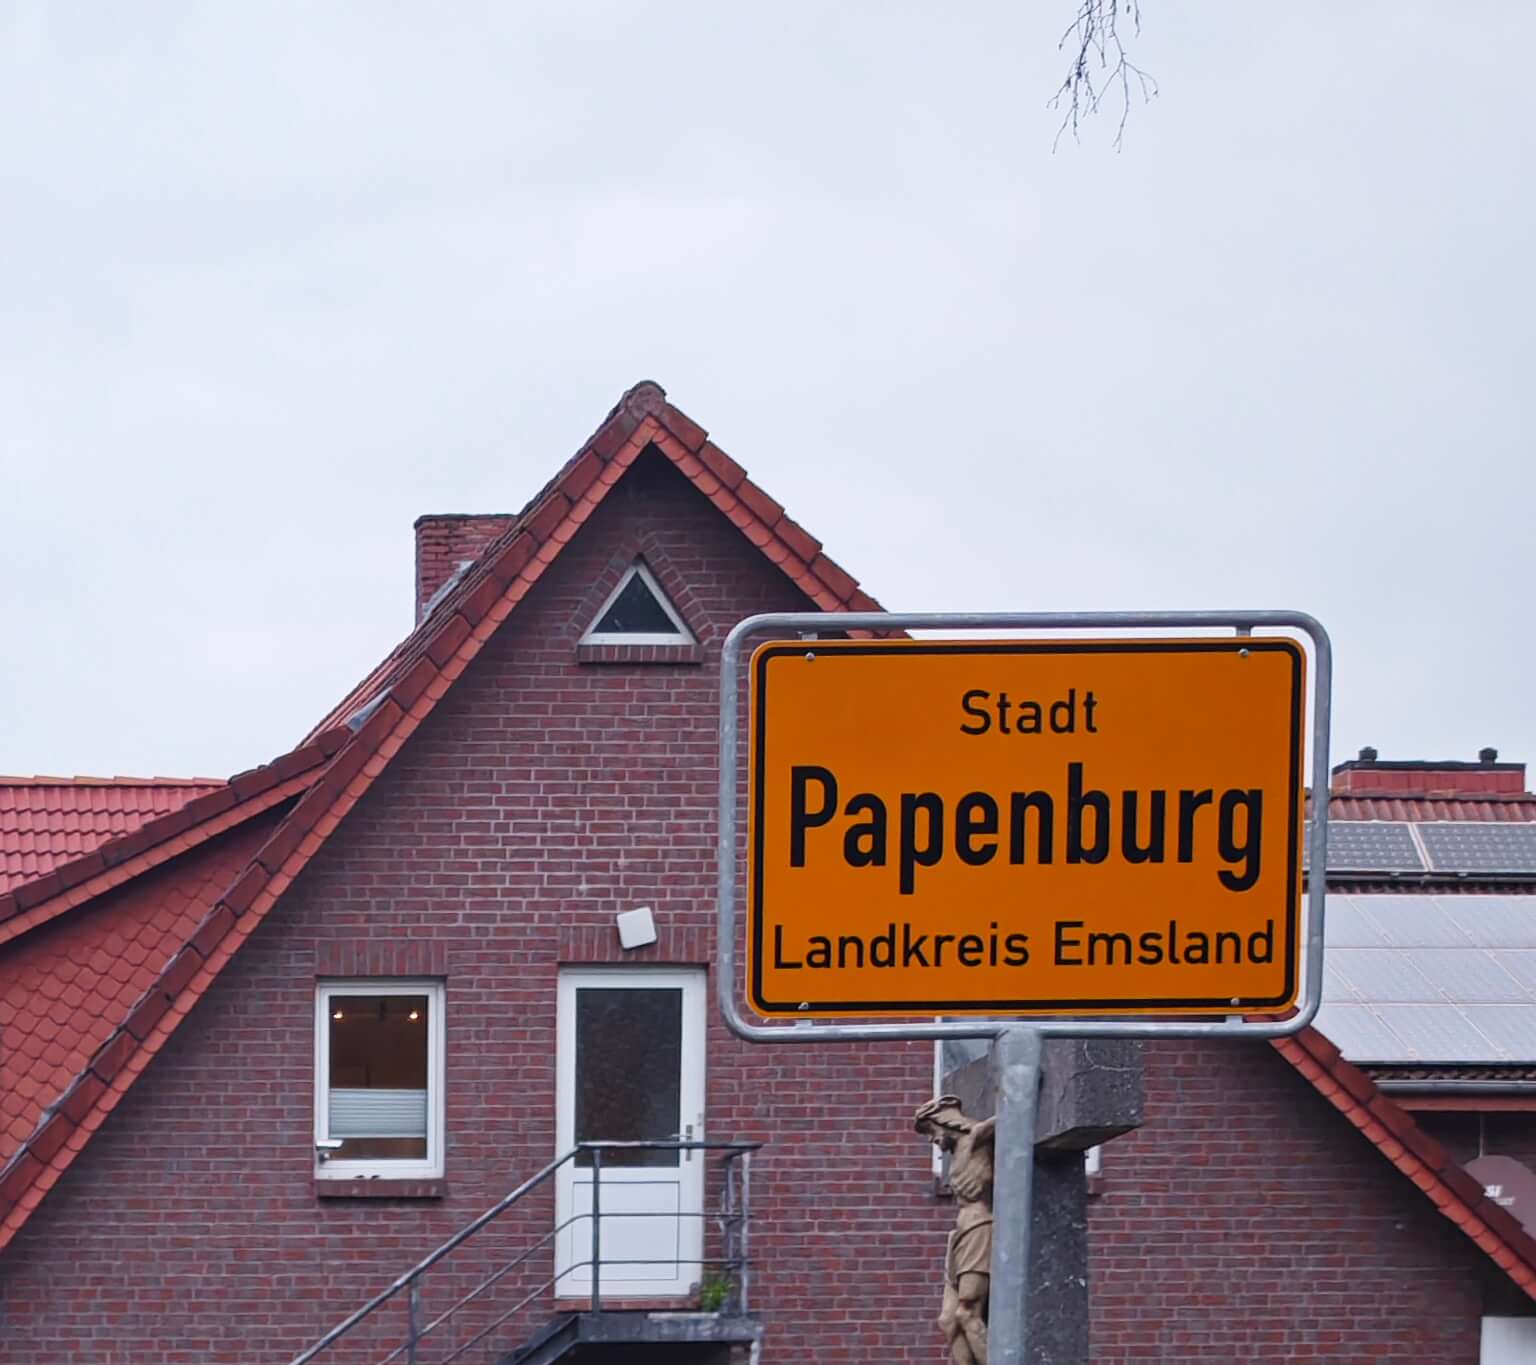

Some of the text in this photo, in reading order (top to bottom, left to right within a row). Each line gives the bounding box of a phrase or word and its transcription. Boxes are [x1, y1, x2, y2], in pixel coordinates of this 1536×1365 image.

[960, 688, 1098, 736] Stadt
[789, 762, 1263, 895] Papenburg
[774, 919, 1274, 969] Landkreis Emsland
